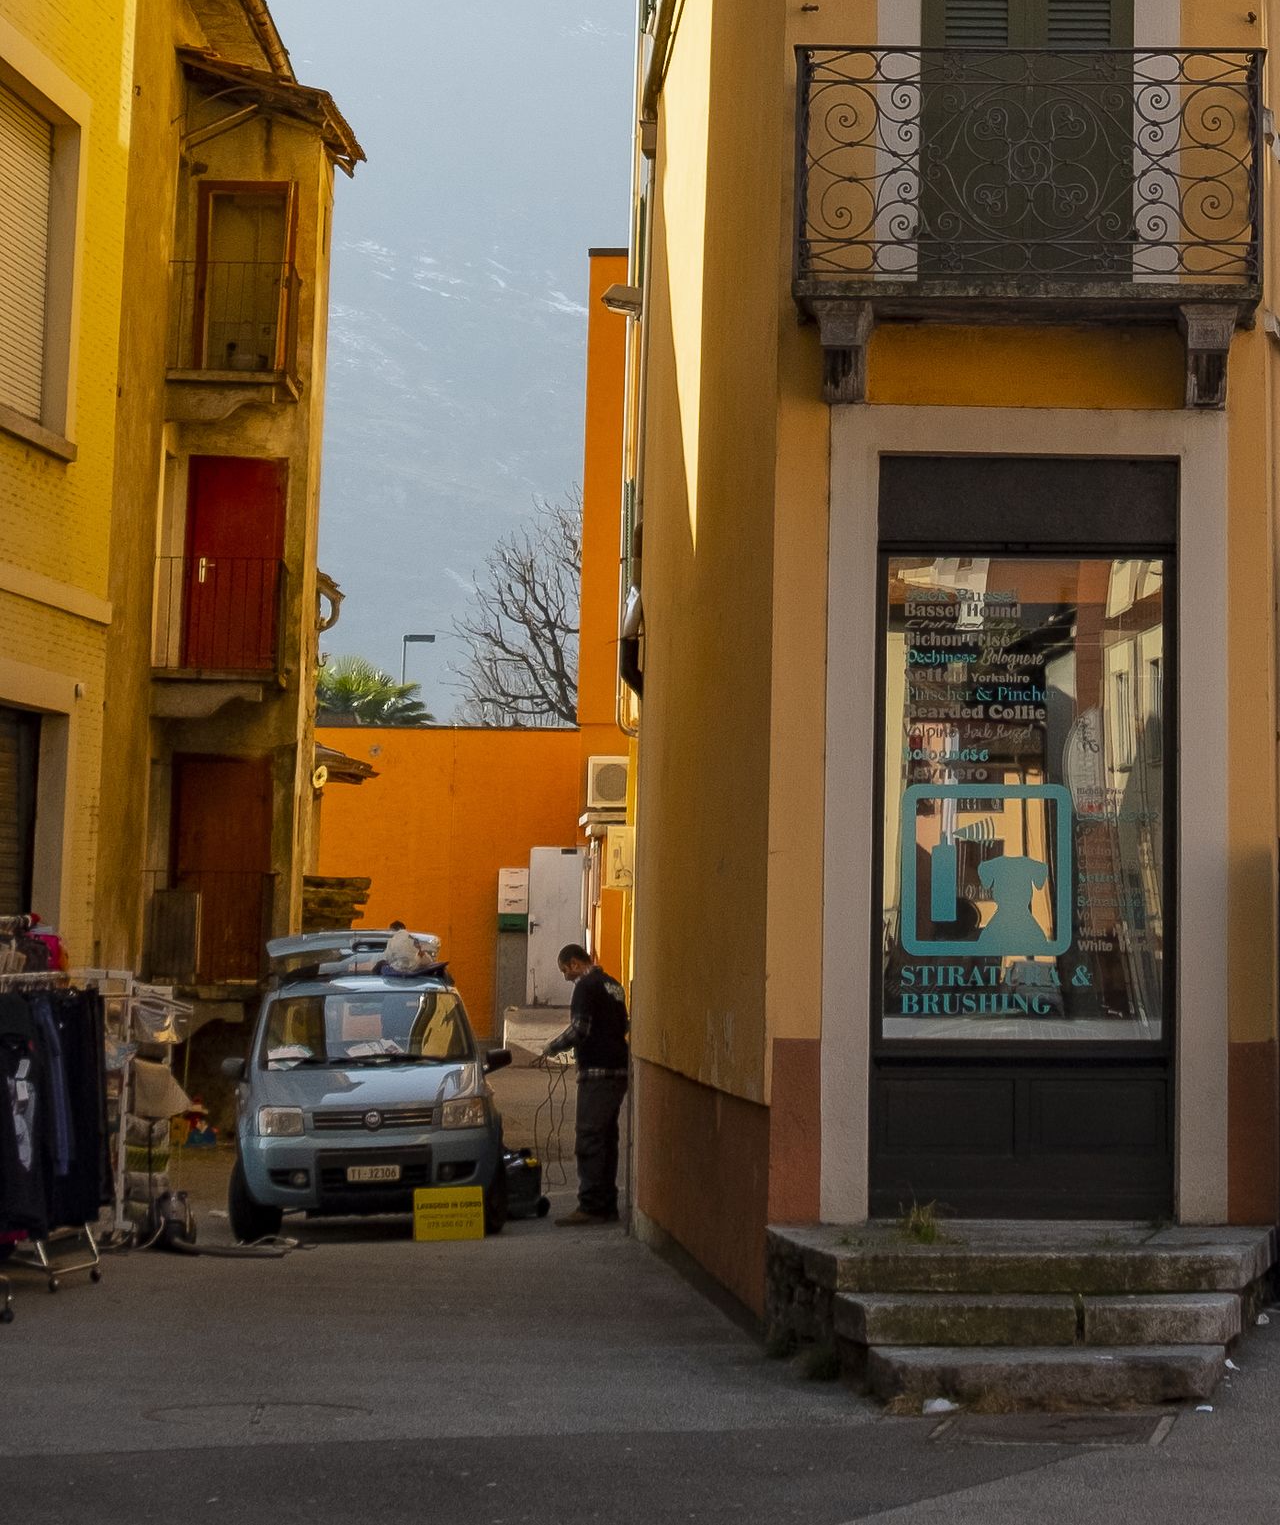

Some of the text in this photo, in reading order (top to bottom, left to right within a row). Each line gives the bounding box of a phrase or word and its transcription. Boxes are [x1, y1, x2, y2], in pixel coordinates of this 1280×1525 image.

[904, 603, 1021, 617] Basset Hound
[904, 631, 962, 646] Bichon
[981, 647, 1044, 670] Bolognese
[970, 673, 1030, 683] Yorkshire
[976, 686, 993, 701] &
[904, 704, 1046, 719] Bearded Collie
[963, 724, 993, 739] Jack
[900, 965, 1093, 987] STIRATURA &
[900, 993, 1051, 1015] BRUSHING
